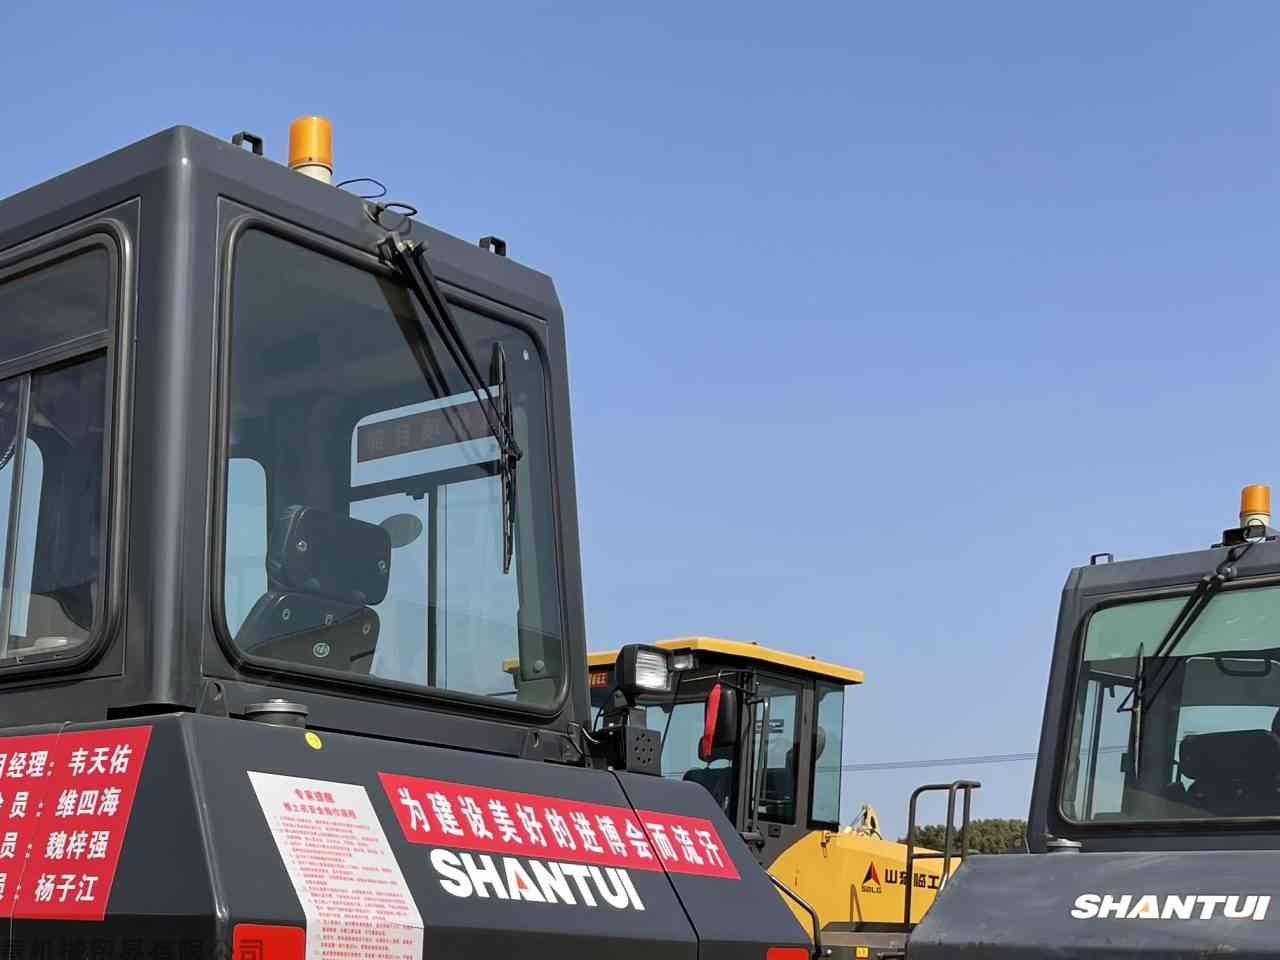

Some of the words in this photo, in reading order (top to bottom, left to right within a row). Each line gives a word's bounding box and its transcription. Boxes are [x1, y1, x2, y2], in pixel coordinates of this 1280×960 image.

[397, 787, 725, 869] 为建设美好的进博会而流汗
[430, 848, 646, 911] SHANTUI
[1071, 894, 1271, 920] SHANTUI
